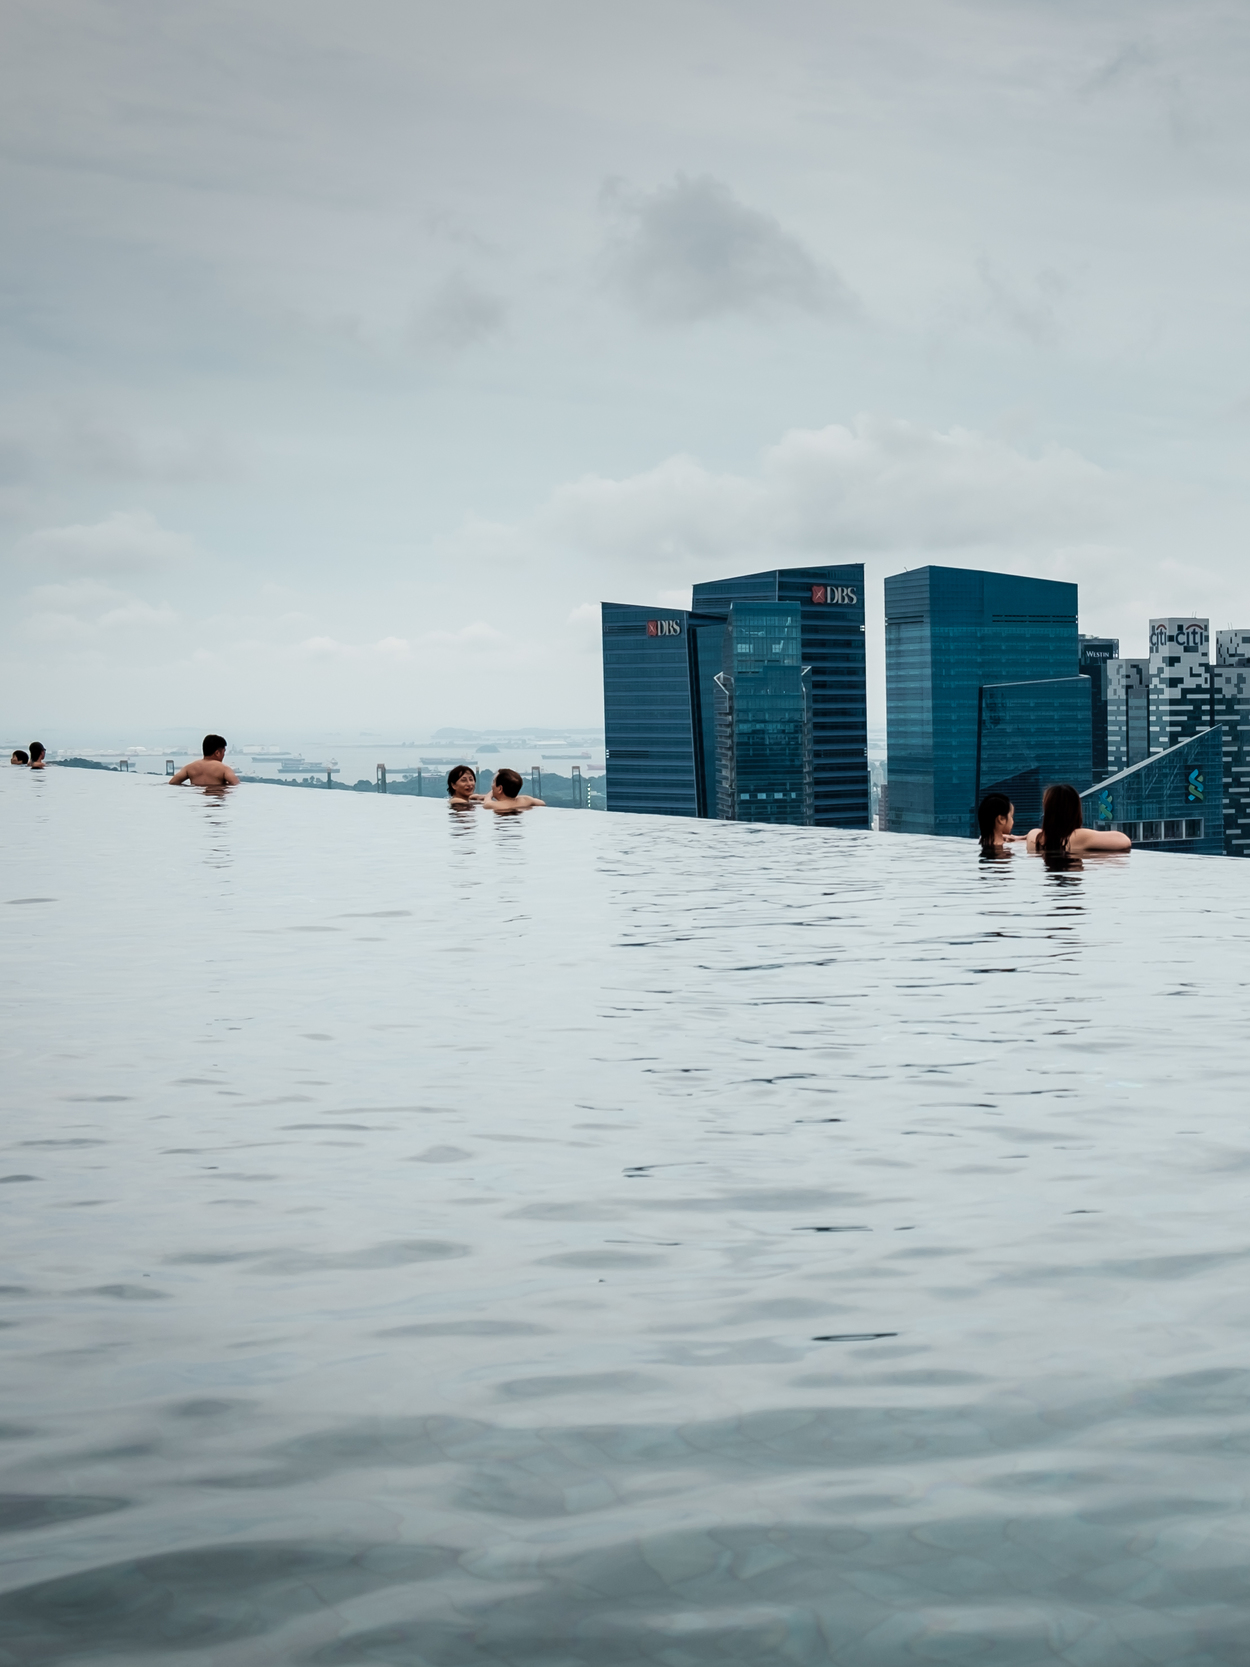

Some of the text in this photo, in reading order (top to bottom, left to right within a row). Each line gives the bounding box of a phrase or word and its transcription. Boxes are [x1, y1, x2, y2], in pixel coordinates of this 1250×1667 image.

[826, 586, 857, 604] DBS
[657, 620, 681, 636] DBS
[1150, 624, 1167, 646] citi
[1175, 624, 1204, 646] citi
